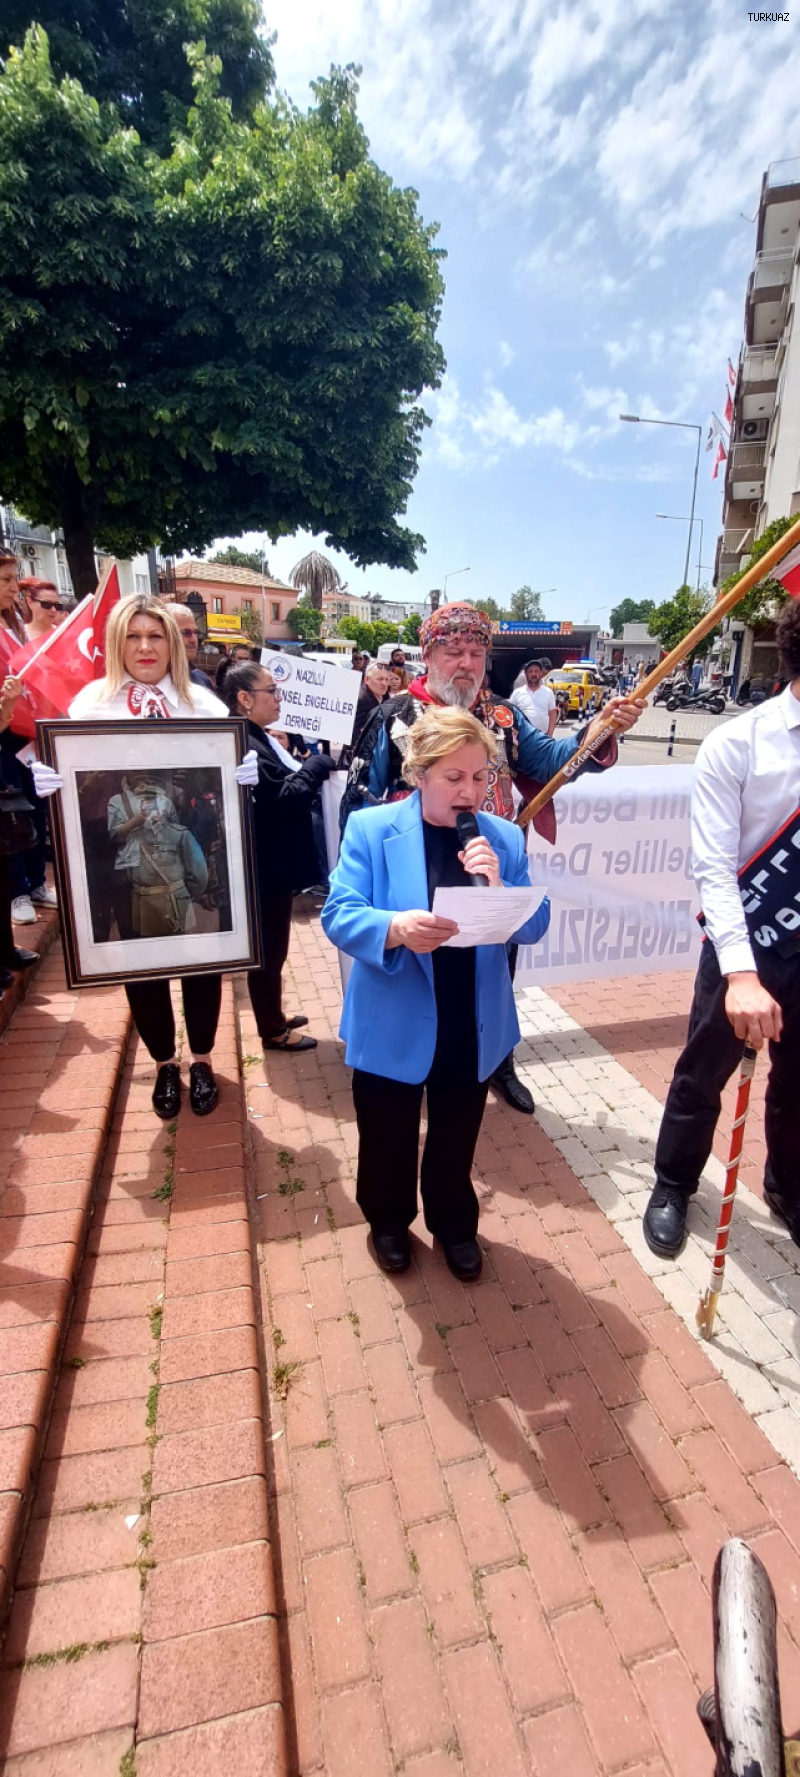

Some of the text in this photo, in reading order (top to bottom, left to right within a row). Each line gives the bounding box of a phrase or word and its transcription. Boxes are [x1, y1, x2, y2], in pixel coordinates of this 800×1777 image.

[295, 667, 327, 687] NAZİLLİ
[279, 688, 302, 706] NSEL
[284, 713, 322, 732] DERNEĞİ
